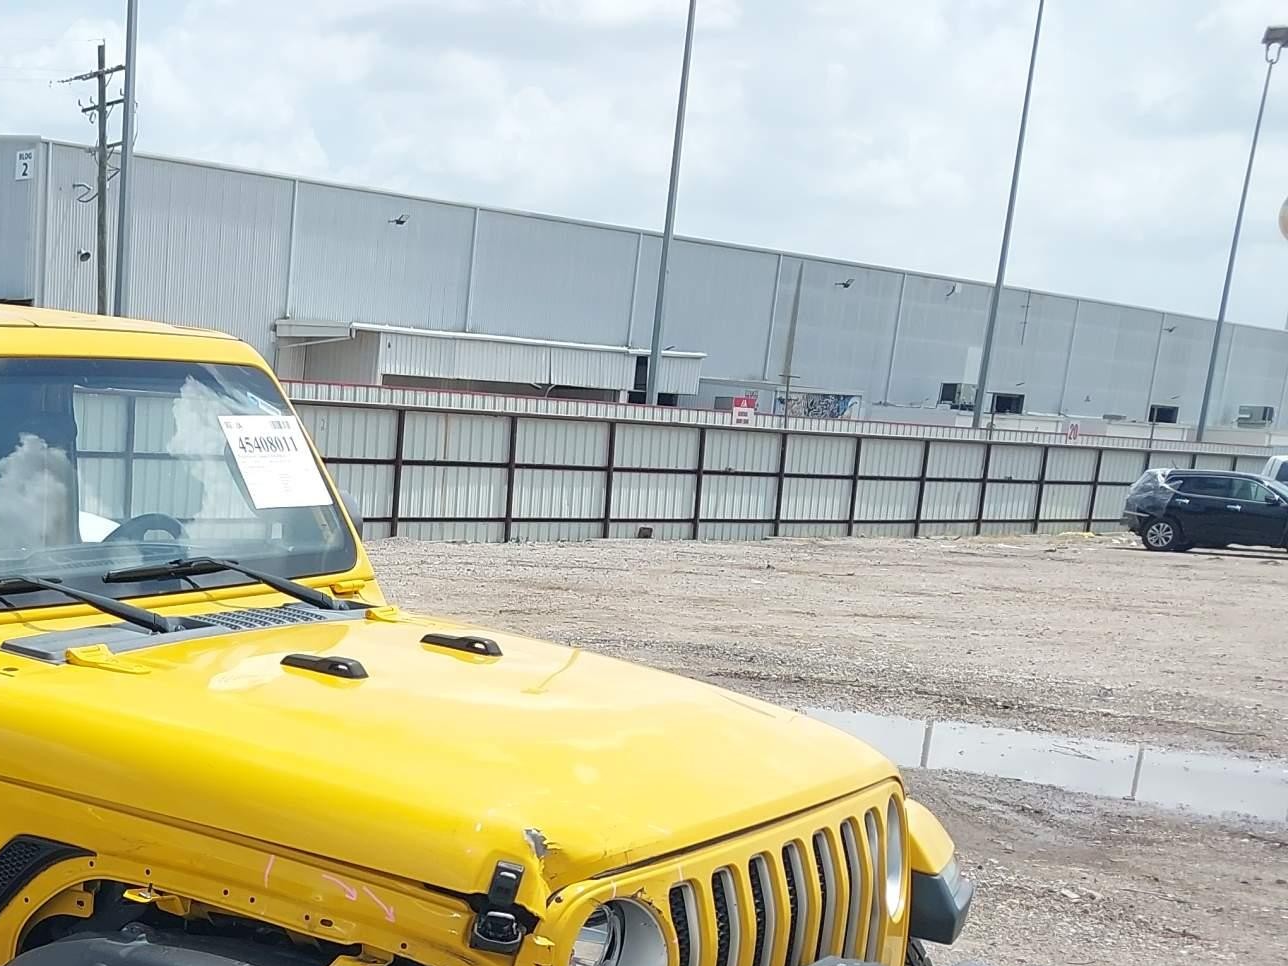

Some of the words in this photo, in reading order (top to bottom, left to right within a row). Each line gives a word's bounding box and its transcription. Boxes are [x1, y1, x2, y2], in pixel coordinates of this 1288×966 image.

[22, 162, 28, 176] 2
[1068, 423, 1078, 440] 20
[238, 436, 298, 453] 45408011
